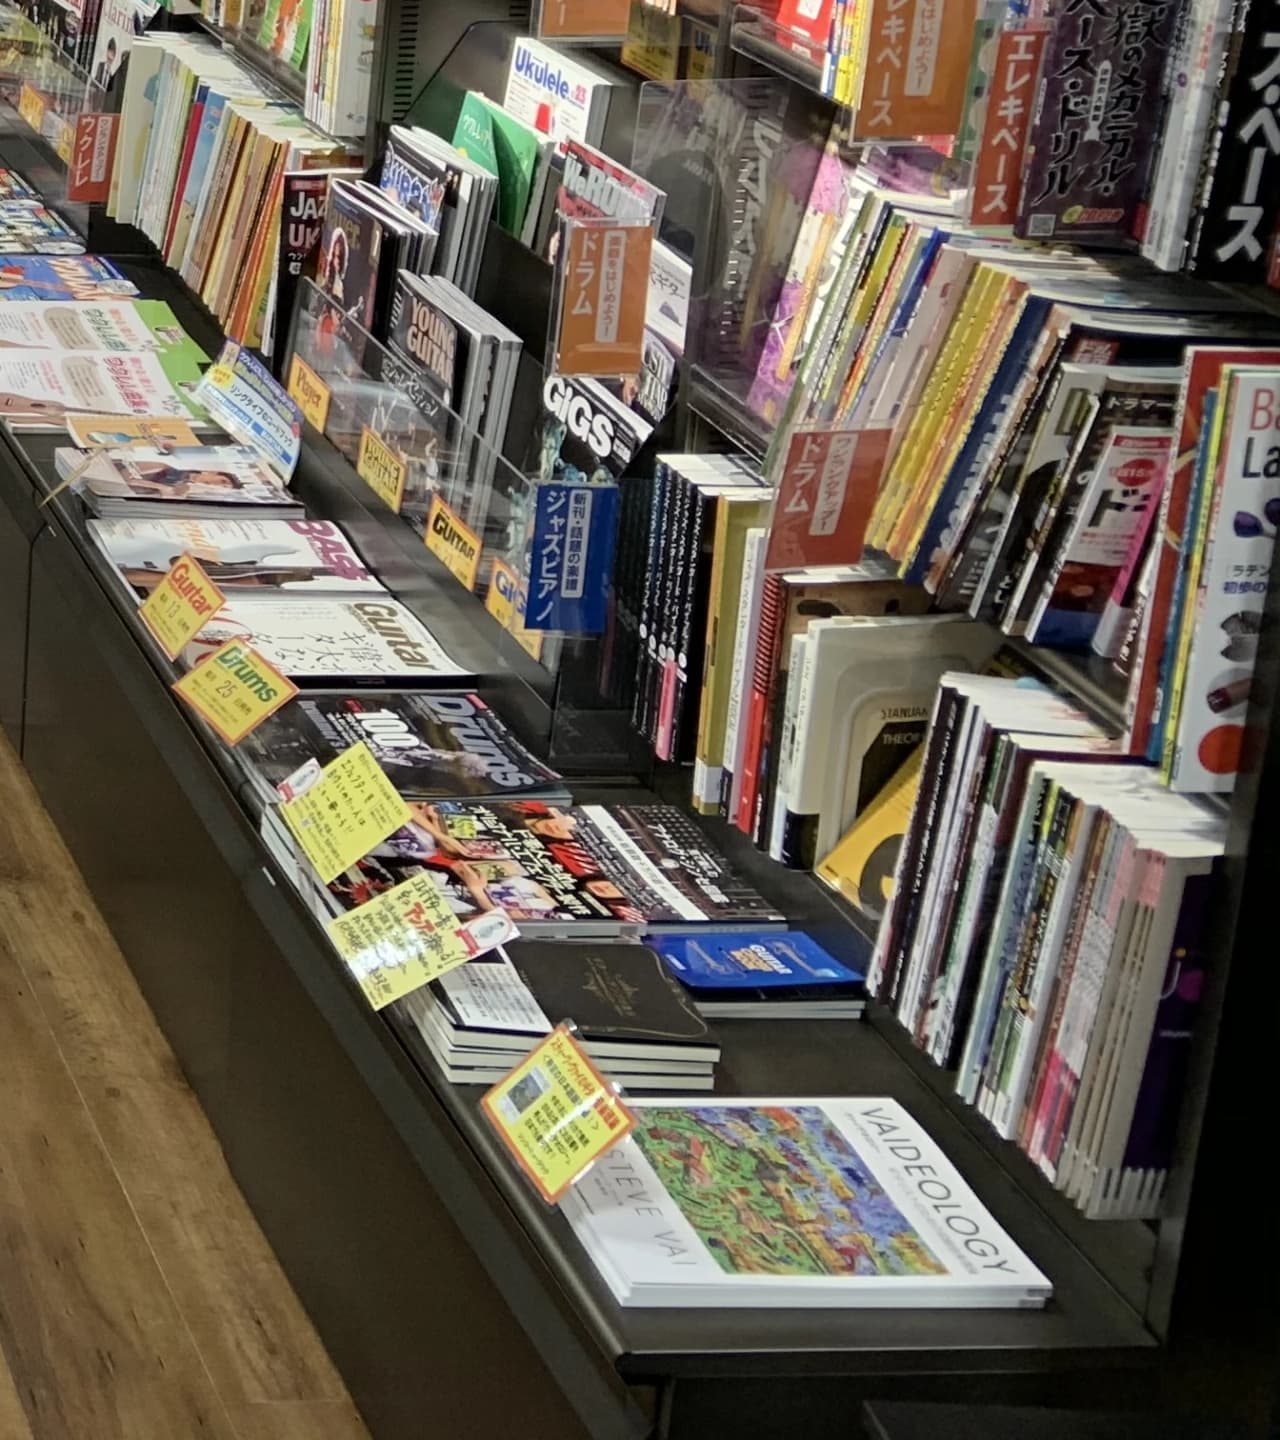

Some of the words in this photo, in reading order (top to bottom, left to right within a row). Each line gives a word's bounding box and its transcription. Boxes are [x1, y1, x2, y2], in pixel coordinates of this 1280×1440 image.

[513, 45, 571, 99] Ukulele
[73, 116, 96, 186] ウクレレ
[985, 34, 1037, 213] エレキベース
[571, 231, 601, 316] ドラム
[410, 296, 457, 353] YOUNG
[543, 376, 616, 459] GIGS
[783, 435, 823, 513] ドラム
[535, 490, 566, 621] ジャズピアノ
[566, 492, 588, 594] 新刊・話題の楽譜
[167, 561, 213, 616] Guitar
[219, 645, 278, 702] Drums
[352, 601, 436, 671] Guitar
[603, 1147, 663, 1218] STEVE
[652, 1228, 698, 1266] VAI
[858, 1106, 1019, 1276] VAIDEOLOGY
